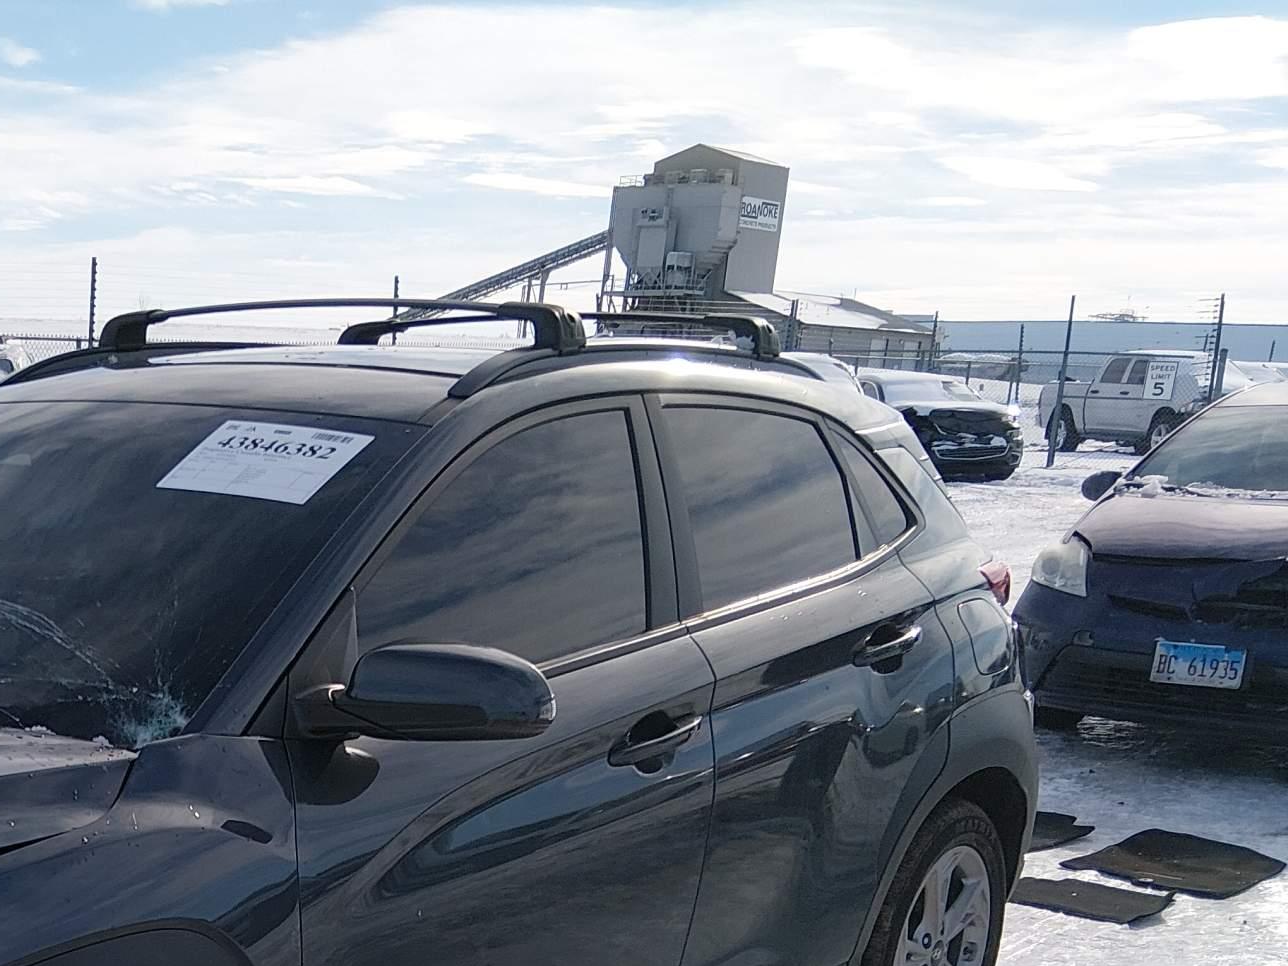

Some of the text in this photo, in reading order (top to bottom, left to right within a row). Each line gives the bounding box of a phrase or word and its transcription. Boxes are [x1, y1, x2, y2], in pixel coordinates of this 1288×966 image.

[741, 202, 778, 218] ROANOKE
[1152, 382, 1165, 396] 5
[217, 435, 337, 460] 43846382
[1157, 654, 1240, 680] BC 61935
